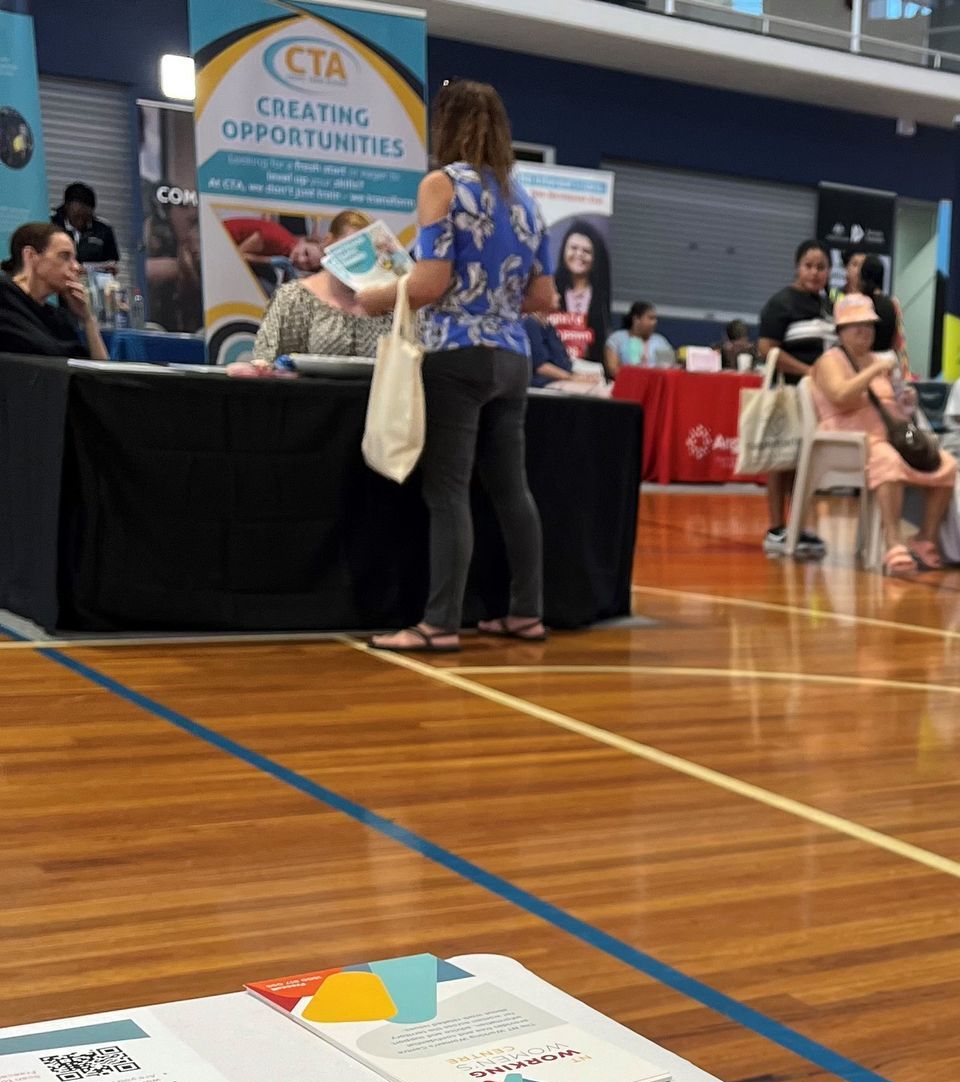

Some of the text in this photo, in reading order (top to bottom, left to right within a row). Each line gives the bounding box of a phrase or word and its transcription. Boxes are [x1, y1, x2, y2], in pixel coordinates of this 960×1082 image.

[284, 47, 346, 80] CTA
[257, 97, 369, 127] CREATING
[222, 120, 404, 157] OPPORTUNITIES
[156, 186, 198, 207] COM
[446, 1046, 514, 1064] CENTRE
[456, 1043, 567, 1070] WOMEN'S
[469, 1050, 582, 1077] WORKING
